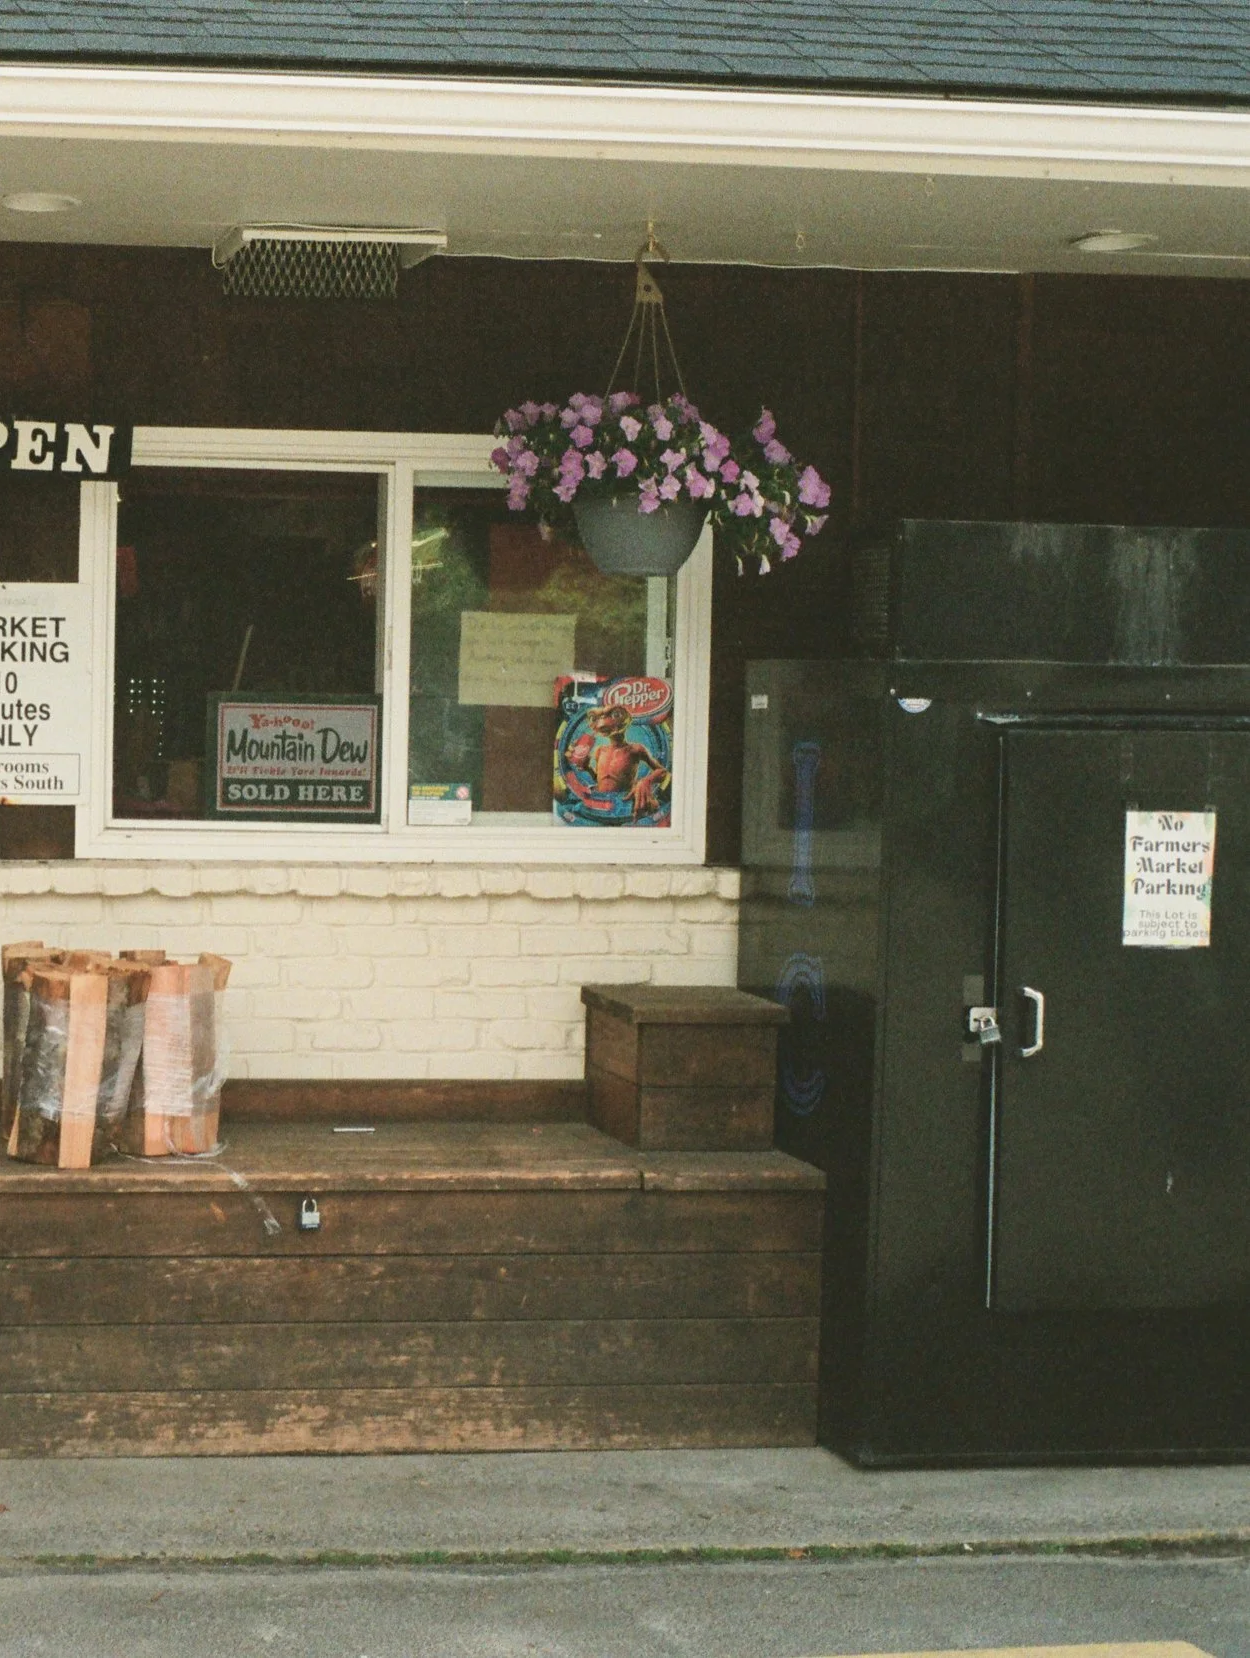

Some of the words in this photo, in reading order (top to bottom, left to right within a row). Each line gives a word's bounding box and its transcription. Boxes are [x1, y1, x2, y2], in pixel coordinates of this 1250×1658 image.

[606, 683, 665, 708] Pepper
[632, 680, 651, 694] Dr.
[226, 727, 315, 764] Mountain
[315, 726, 368, 765] Dew
[13, 776, 64, 791] South
[228, 783, 291, 801] SOLD
[297, 784, 364, 802] HERE
[1158, 814, 1184, 831] No
[1131, 835, 1210, 853] Farmers
[1136, 856, 1204, 874] Market
[1131, 877, 1206, 901] Parking
[1139, 909, 1161, 919] This
[1164, 910, 1184, 919] Lot
[1188, 910, 1198, 919] is
[1138, 919, 1180, 930] subject
[1184, 920, 1198, 929] to
